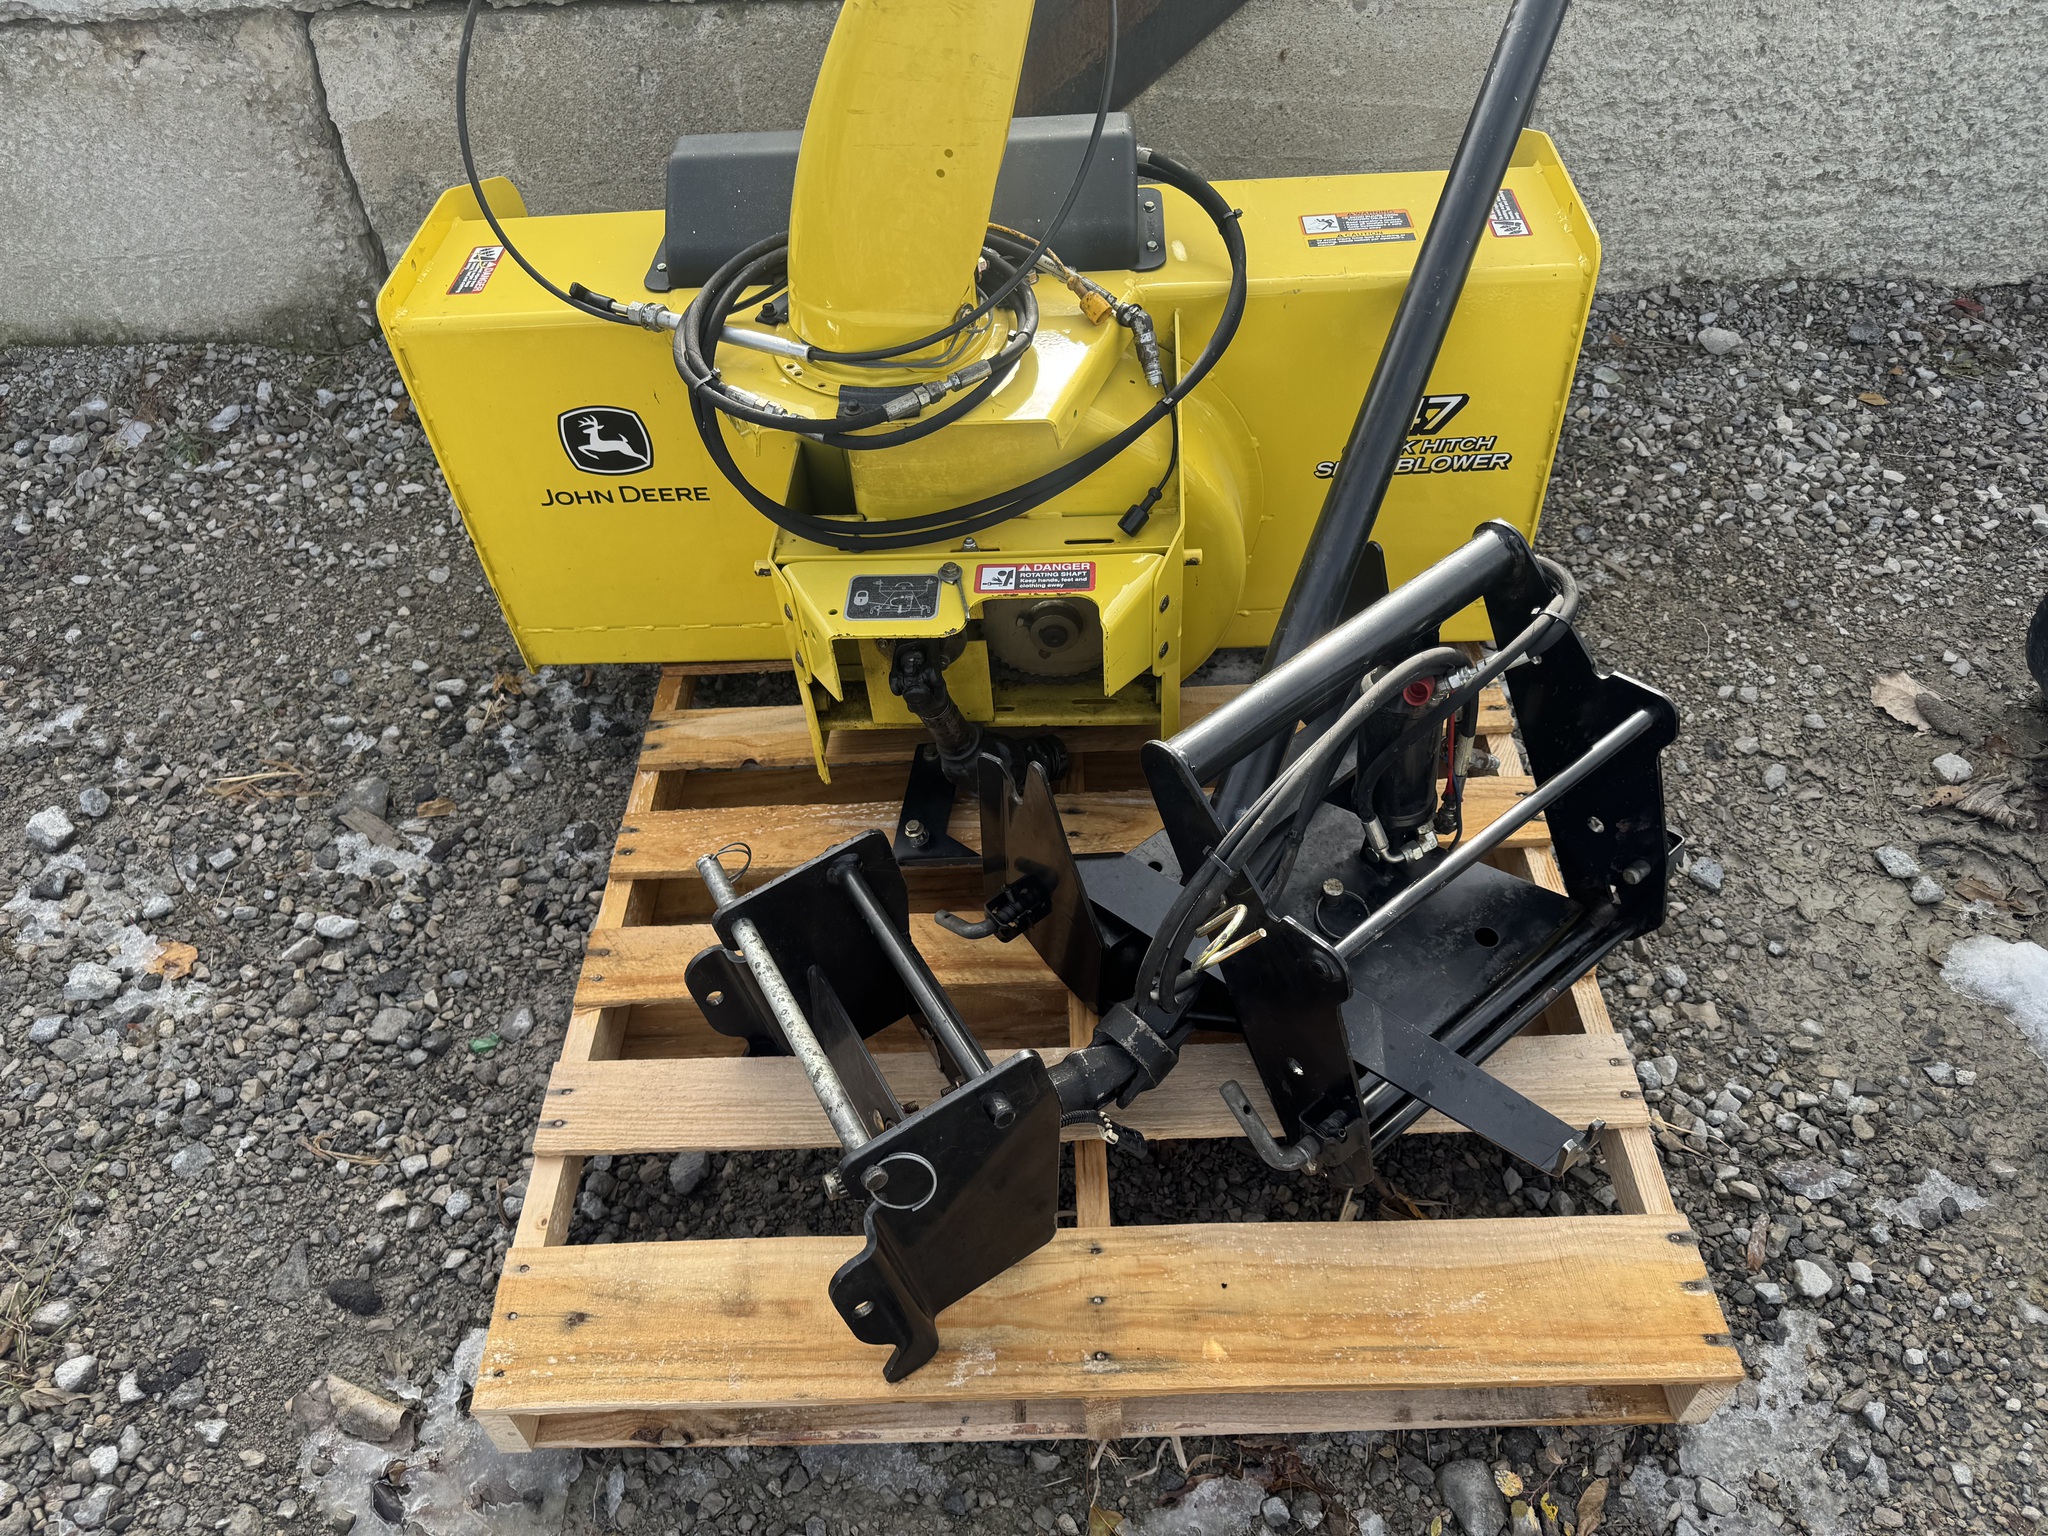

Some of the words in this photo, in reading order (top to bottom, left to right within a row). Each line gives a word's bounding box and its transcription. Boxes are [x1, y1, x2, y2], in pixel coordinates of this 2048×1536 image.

[472, 267, 495, 292] DANGER
[1420, 435, 1498, 455] HITCH
[1314, 452, 1512, 479] SBLOWER
[541, 489, 615, 507] JOHN
[618, 485, 711, 503] DEERE
[1033, 562, 1091, 572] DANGER
